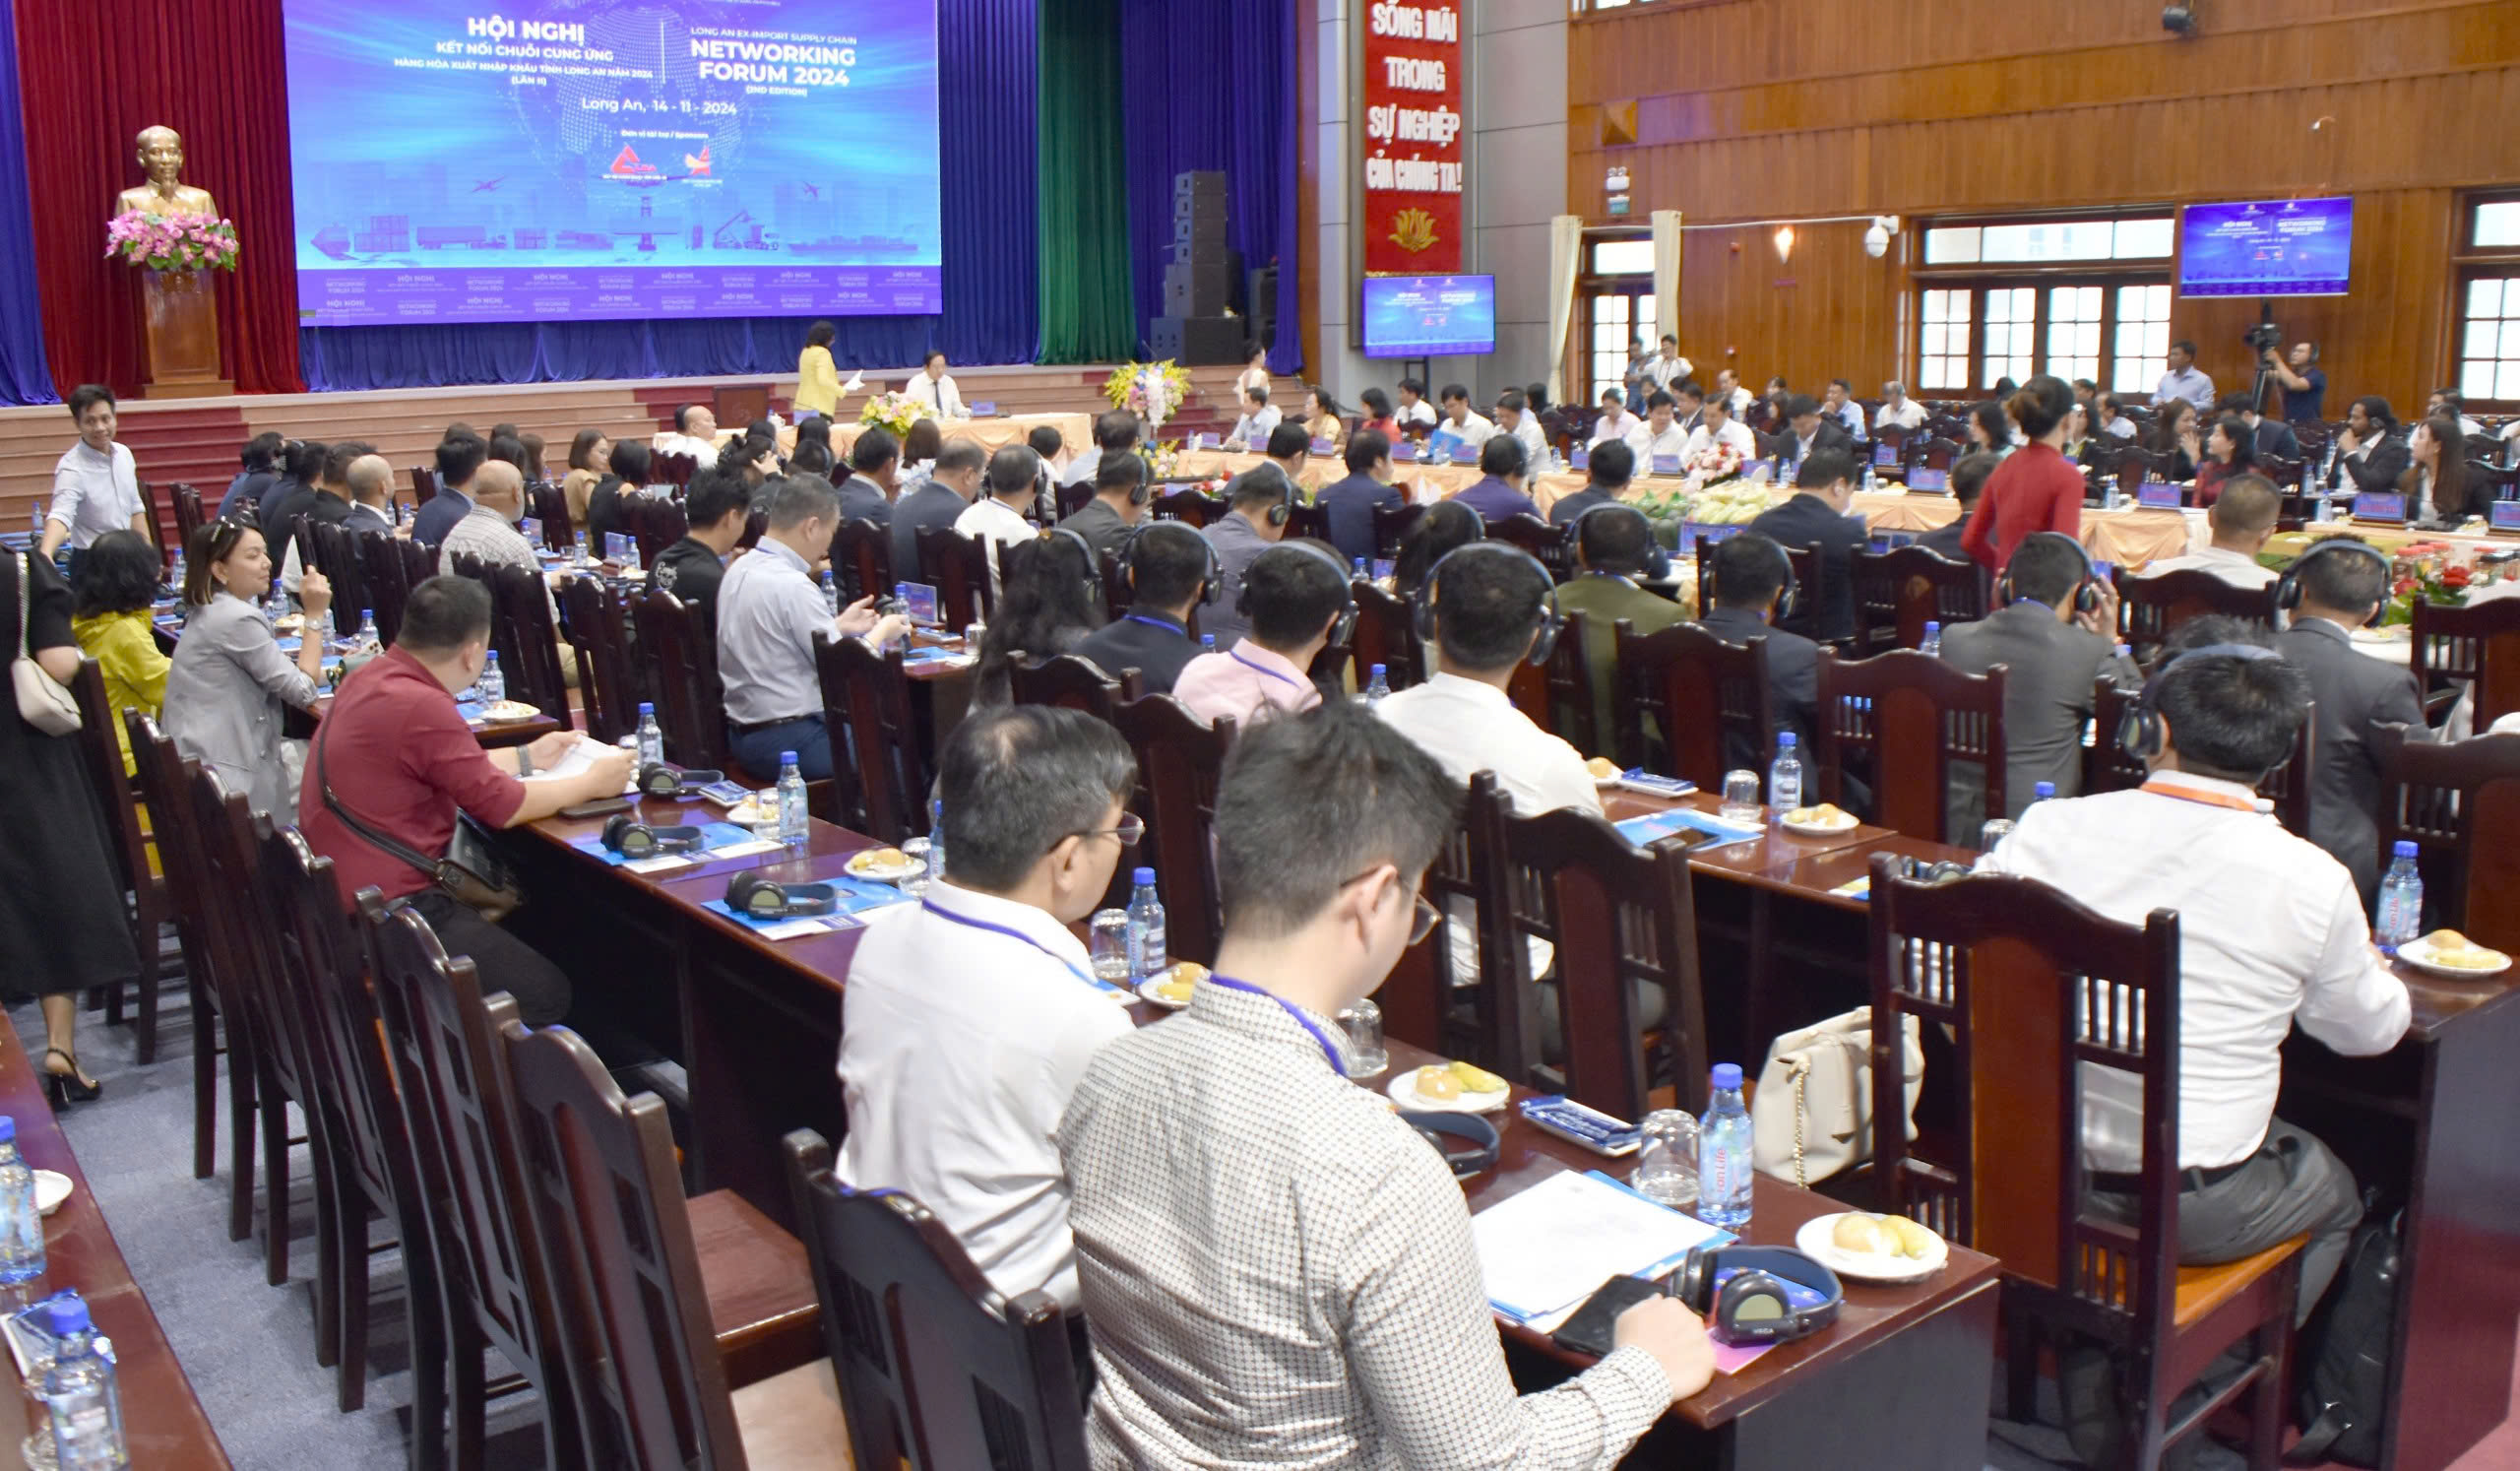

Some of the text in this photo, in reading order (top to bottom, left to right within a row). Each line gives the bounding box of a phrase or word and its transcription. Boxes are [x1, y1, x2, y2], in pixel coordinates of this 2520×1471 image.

[468, 15, 585, 47] HỘI NGHỊ
[691, 27, 857, 44] LONG AN EX-IMPORT SUPPLY CHAIN
[1424, 6, 1457, 42] MÃI
[436, 39, 614, 62] KẾT NỐI CHUỖI CUNG ỨNG
[691, 38, 856, 66] NETWORKING
[394, 57, 424, 68] HÀNG
[452, 59, 477, 70] XUẤT
[479, 61, 508, 73] NHẬP
[564, 66, 591, 76] LONG
[593, 67, 606, 76] AN
[631, 69, 654, 79] 2024
[537, 76, 546, 87] II)
[700, 61, 850, 88] FORUM 2024
[1384, 56, 1446, 92] TRONG
[746, 85, 808, 96] (2ND EDITION)
[582, 96, 619, 113] Long
[622, 98, 647, 114] An,
[653, 99, 668, 112] 14
[679, 99, 691, 113] 11
[702, 101, 737, 115] 2024
[1368, 102, 1461, 148] SỰ NGHIỆP
[1366, 149, 1463, 192] CỦA CHÚNG TA!
